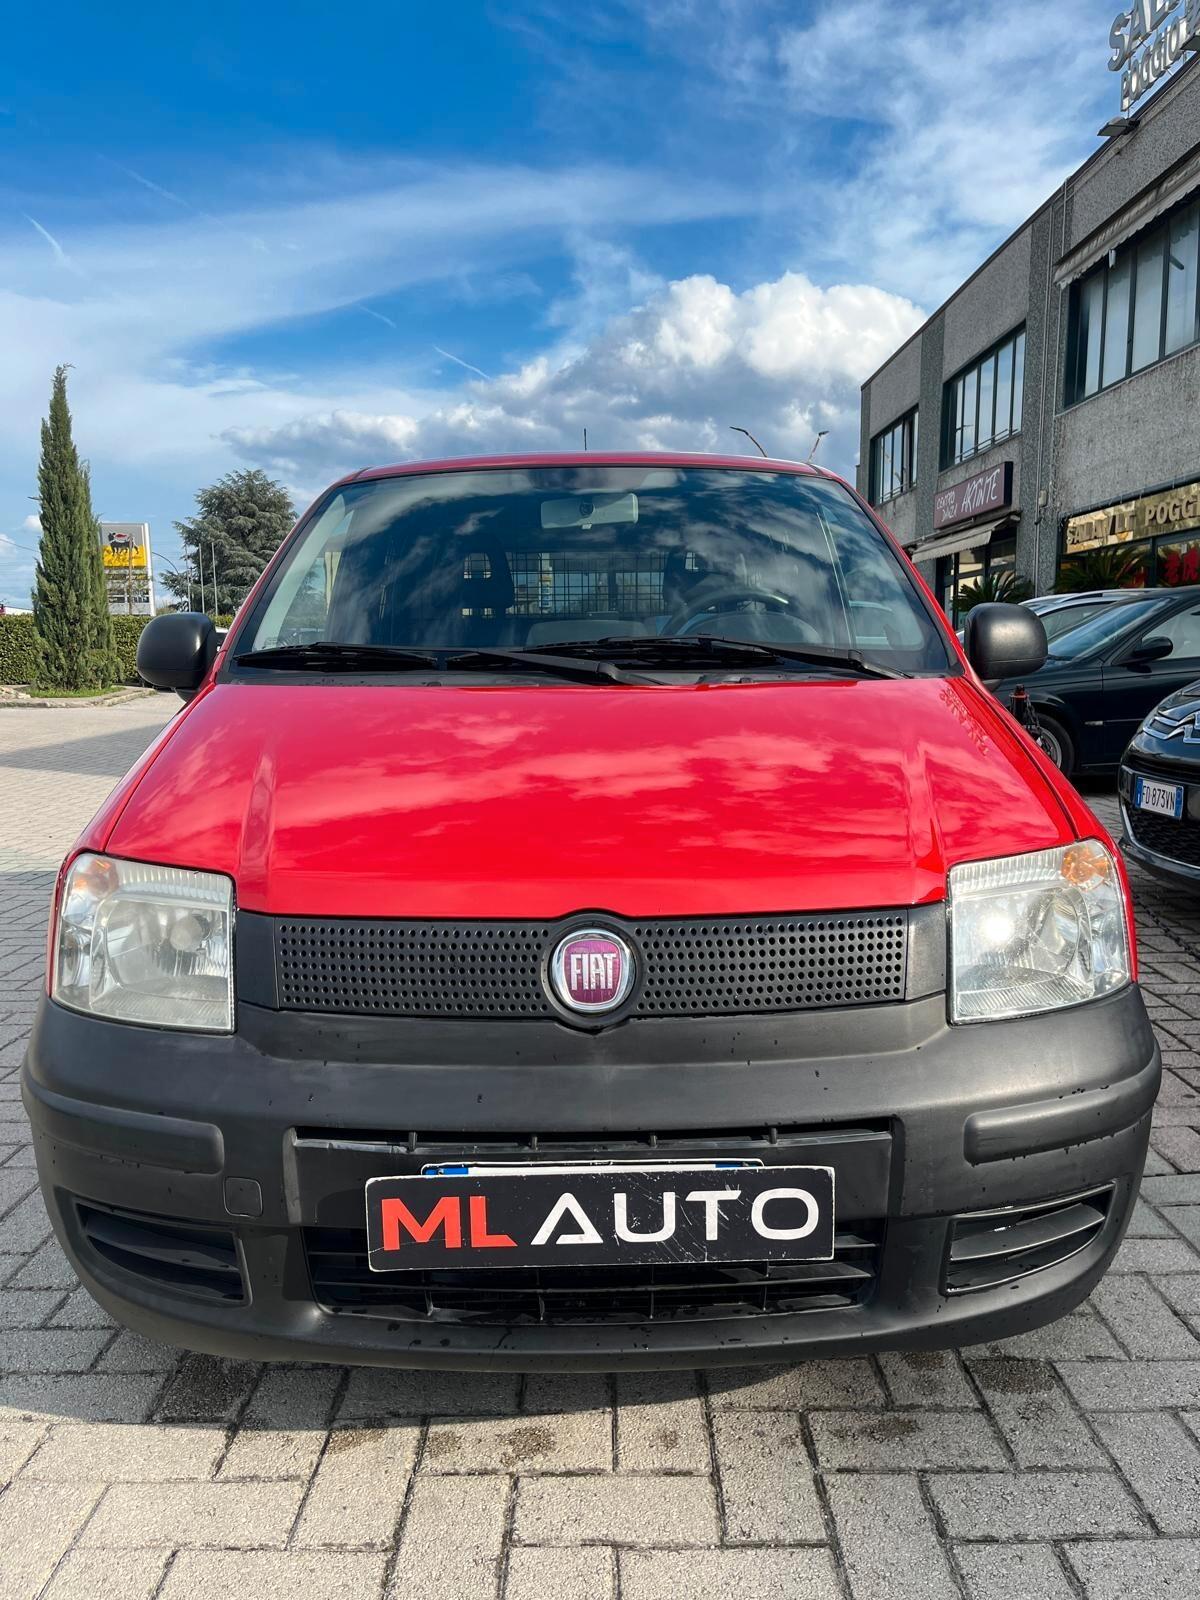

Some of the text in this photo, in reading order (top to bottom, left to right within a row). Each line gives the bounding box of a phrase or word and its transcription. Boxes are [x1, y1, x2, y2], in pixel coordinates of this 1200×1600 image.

[570, 953, 617, 991] FIAT
[381, 1187, 819, 1251] ML AUTO
